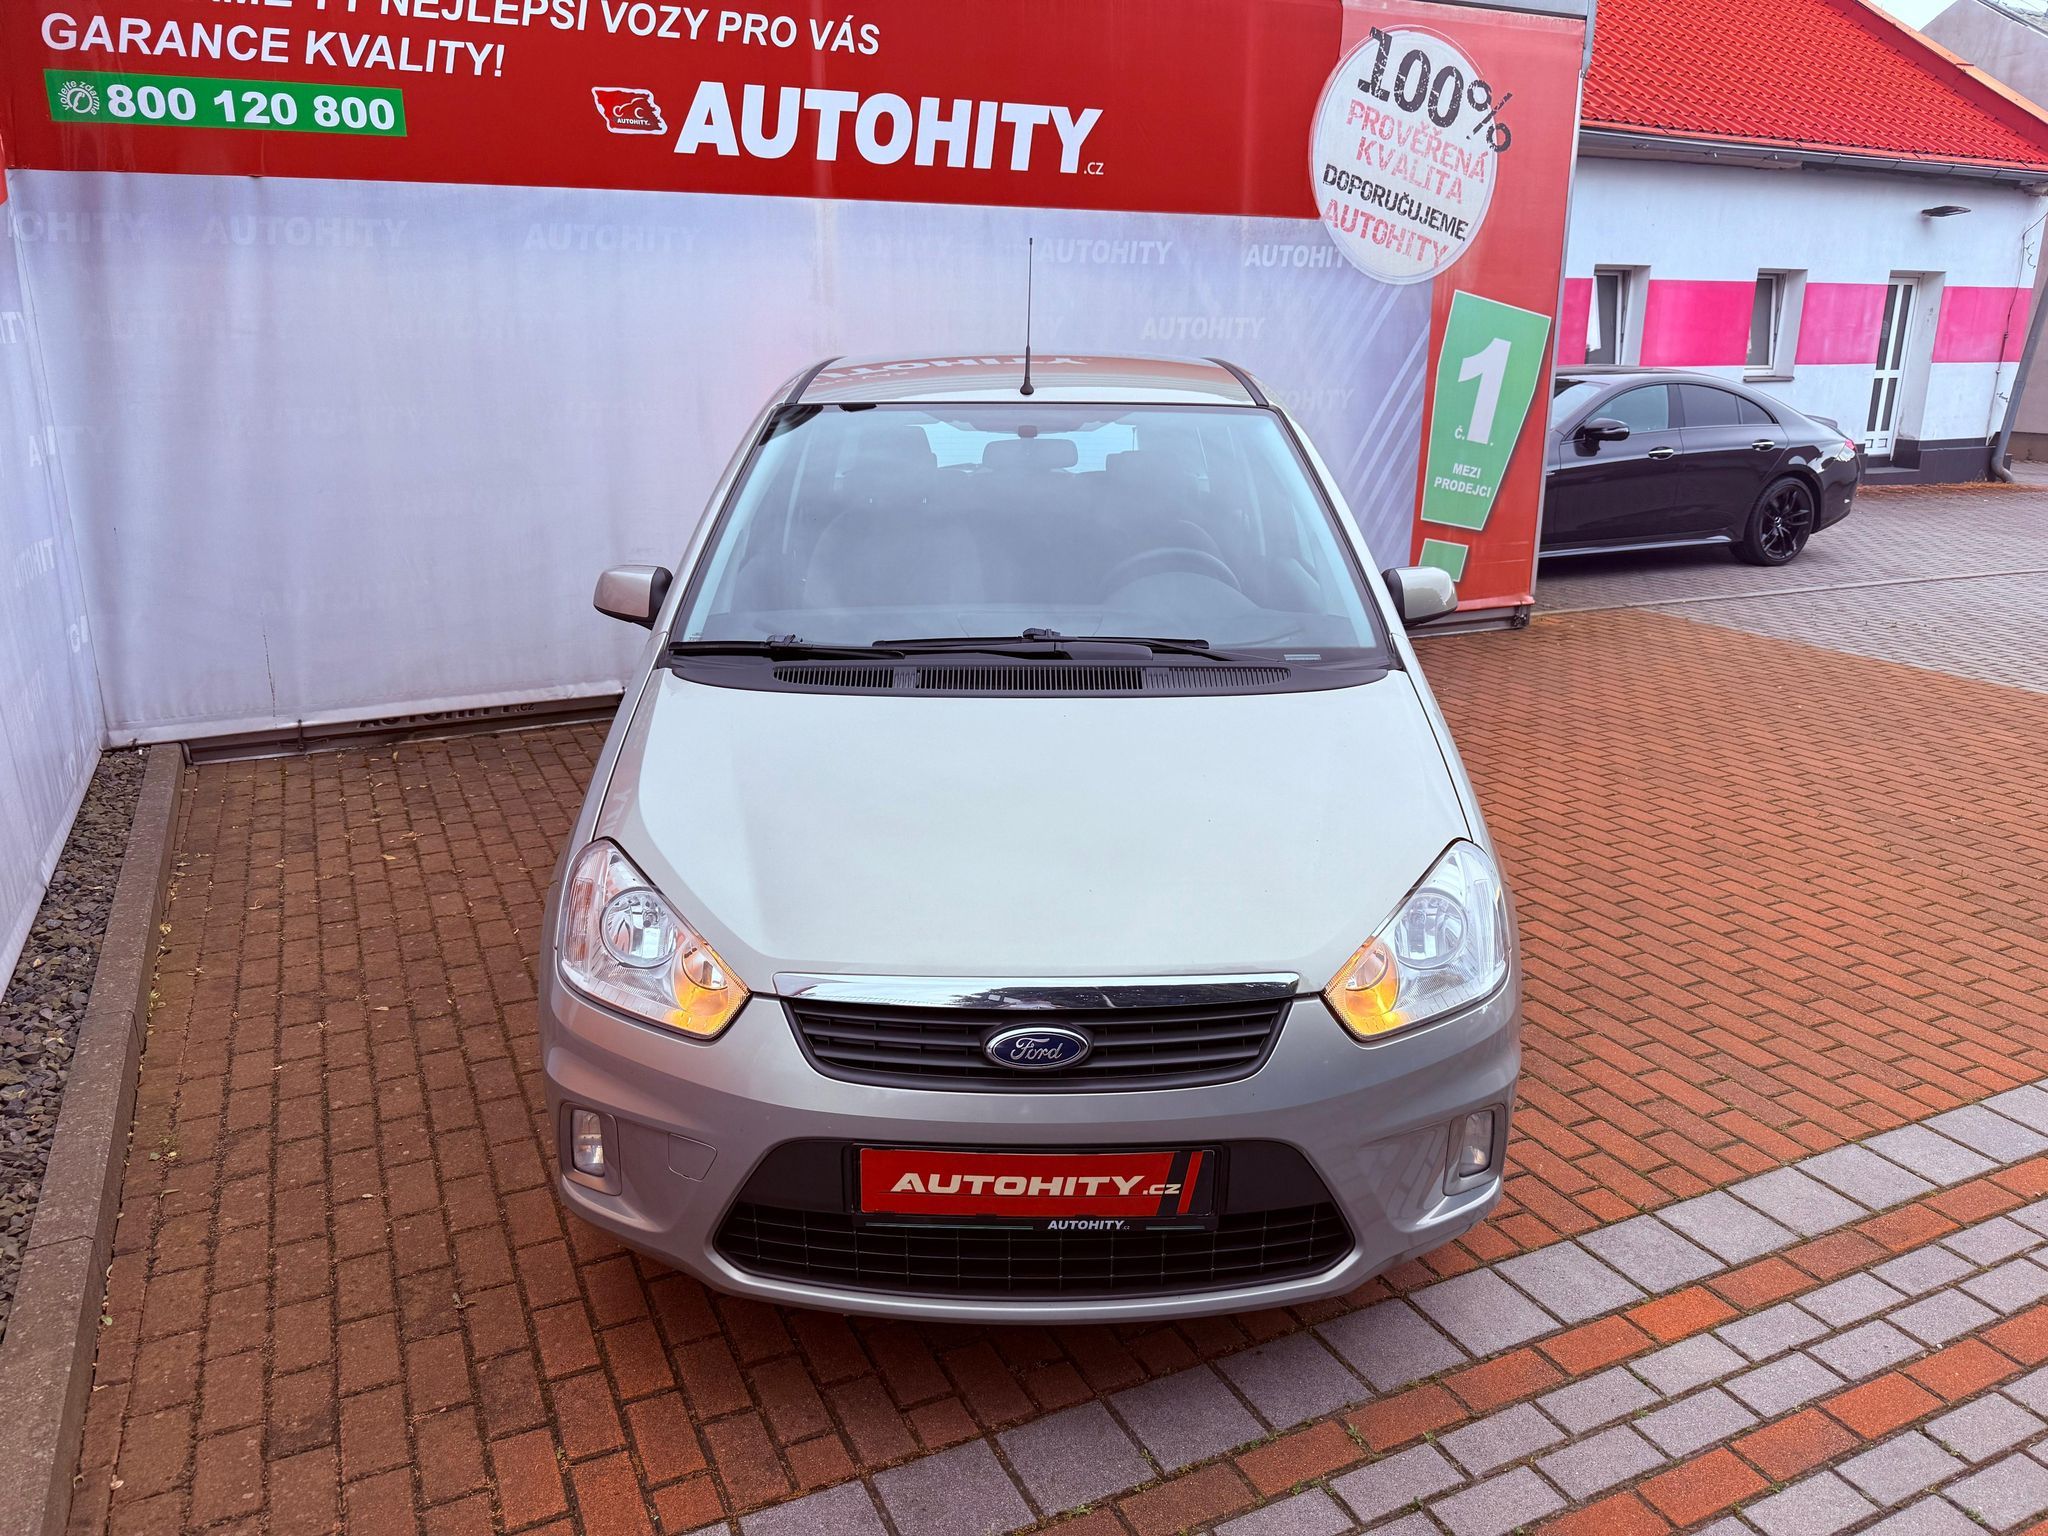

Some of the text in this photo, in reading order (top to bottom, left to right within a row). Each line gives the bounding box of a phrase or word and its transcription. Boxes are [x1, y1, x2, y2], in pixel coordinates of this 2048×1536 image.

[41, 12, 505, 77] GARANCE KVALITY!
[602, 1, 709, 40] VOZY
[717, 11, 797, 48] PRO
[809, 14, 880, 55] VÁS
[107, 84, 396, 130] 800 120 800
[1357, 26, 1514, 153] 100%
[1346, 98, 1490, 184] PROVĚŘENÁ
[1356, 136, 1464, 204] KVALITA
[1322, 163, 1470, 242] DOPORUČUJEME
[1039, 238, 1173, 265] AUTOHITY
[1244, 244, 1344, 268] AUTOHIT
[1324, 198, 1449, 270] AUTOHITY
[1434, 476, 1492, 499] PRODEJCI
[1452, 463, 1482, 479] MEZI
[1010, 1037, 1063, 1060] Ford
